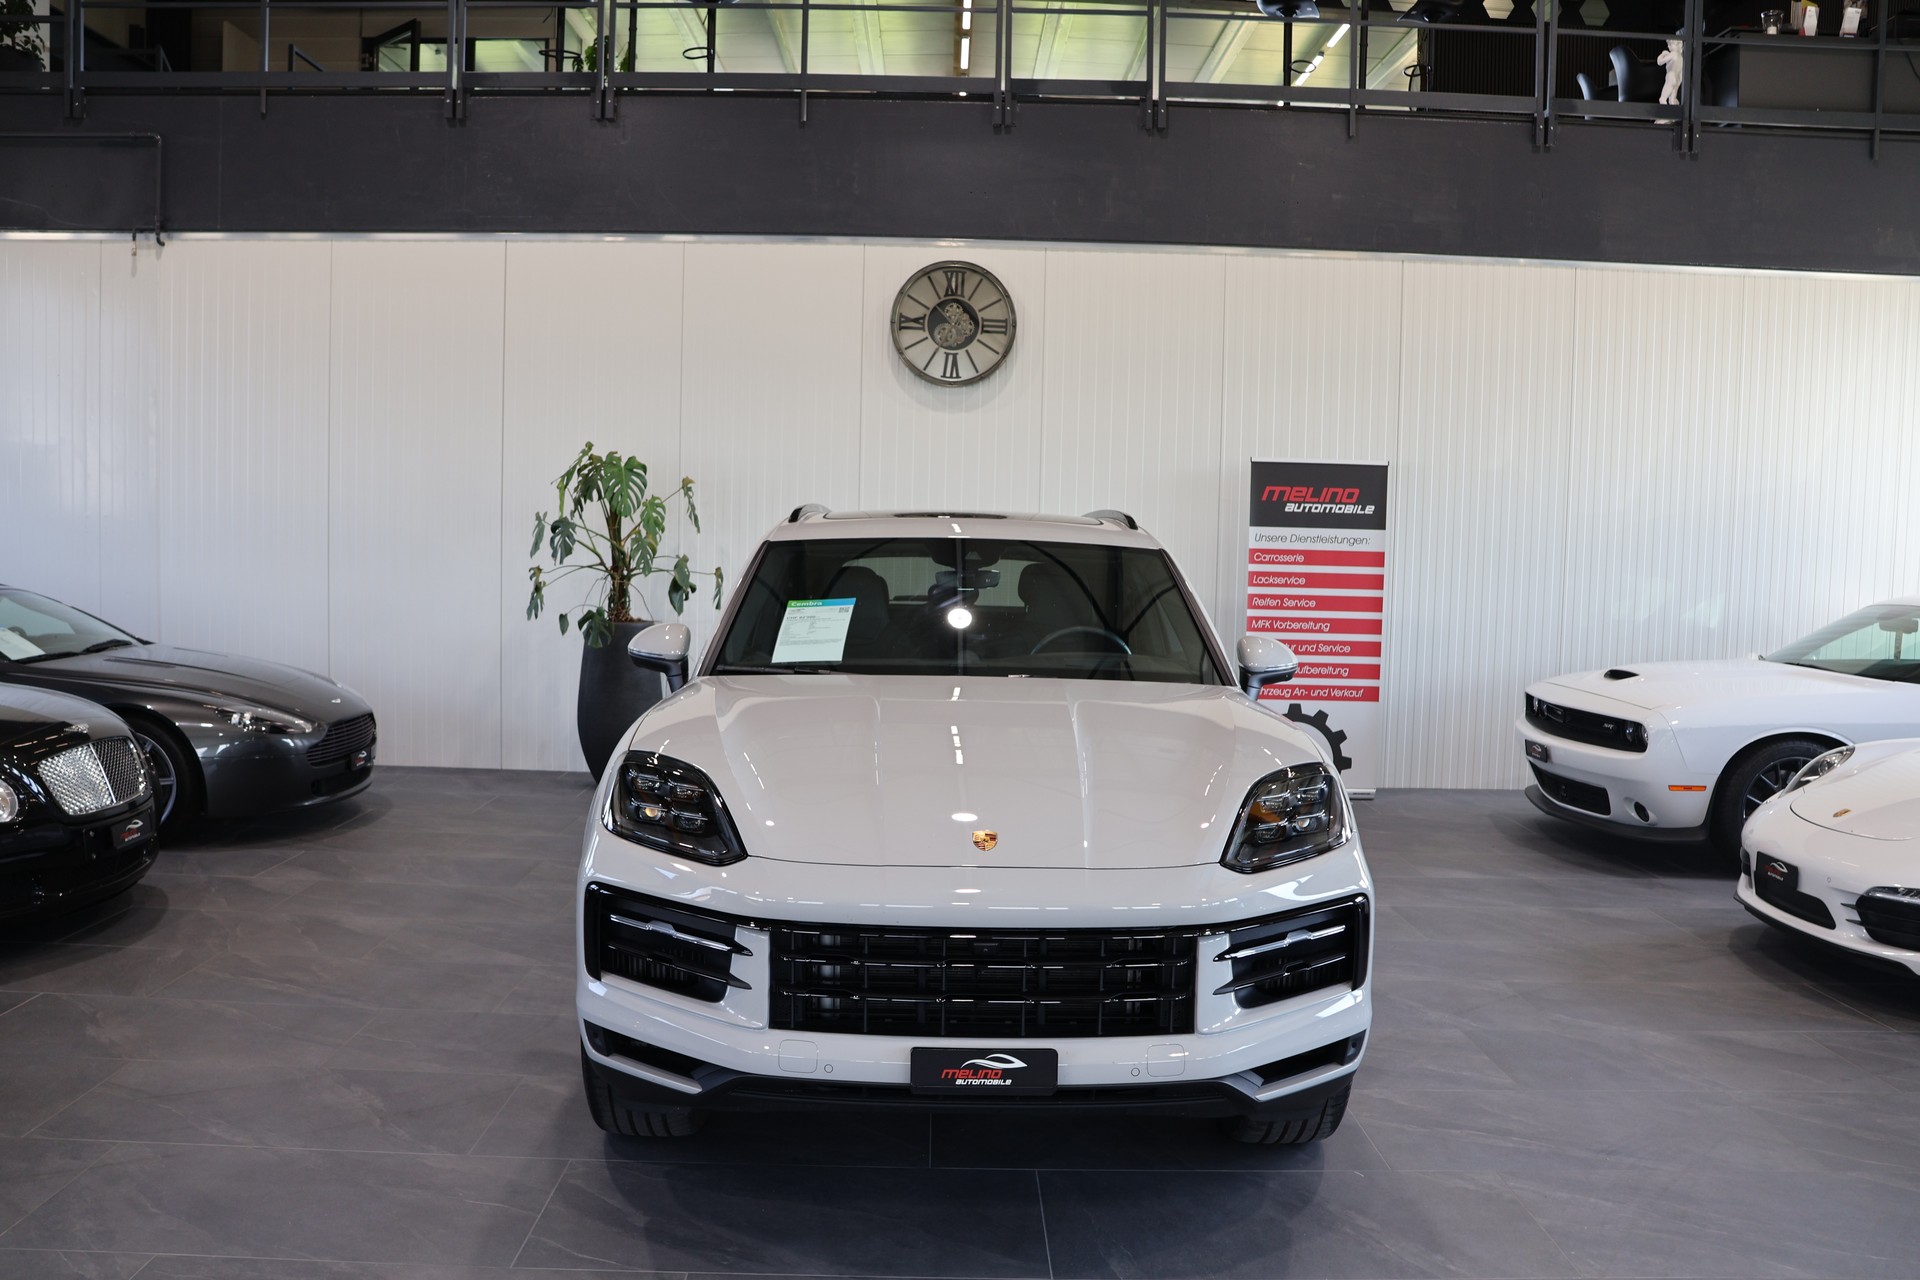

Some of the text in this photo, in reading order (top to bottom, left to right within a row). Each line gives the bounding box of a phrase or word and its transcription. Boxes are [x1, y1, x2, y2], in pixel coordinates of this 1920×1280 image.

[942, 270, 967, 298] XII
[980, 316, 1008, 336] III
[1254, 533, 1371, 546] Unsere Dienstleistungen:
[1253, 552, 1305, 563] Carrosserie
[1252, 574, 1306, 585] Lackservice
[1252, 597, 1317, 608] Reifen Service
[1251, 619, 1331, 632] MFK Vorbereitung
[1298, 643, 1316, 653] und
[1317, 643, 1351, 653] Service
[1295, 665, 1350, 677] ufbereitung
[1292, 687, 1308, 697] An-
[1310, 687, 1328, 697] und
[1330, 687, 1364, 698] Verkauf
